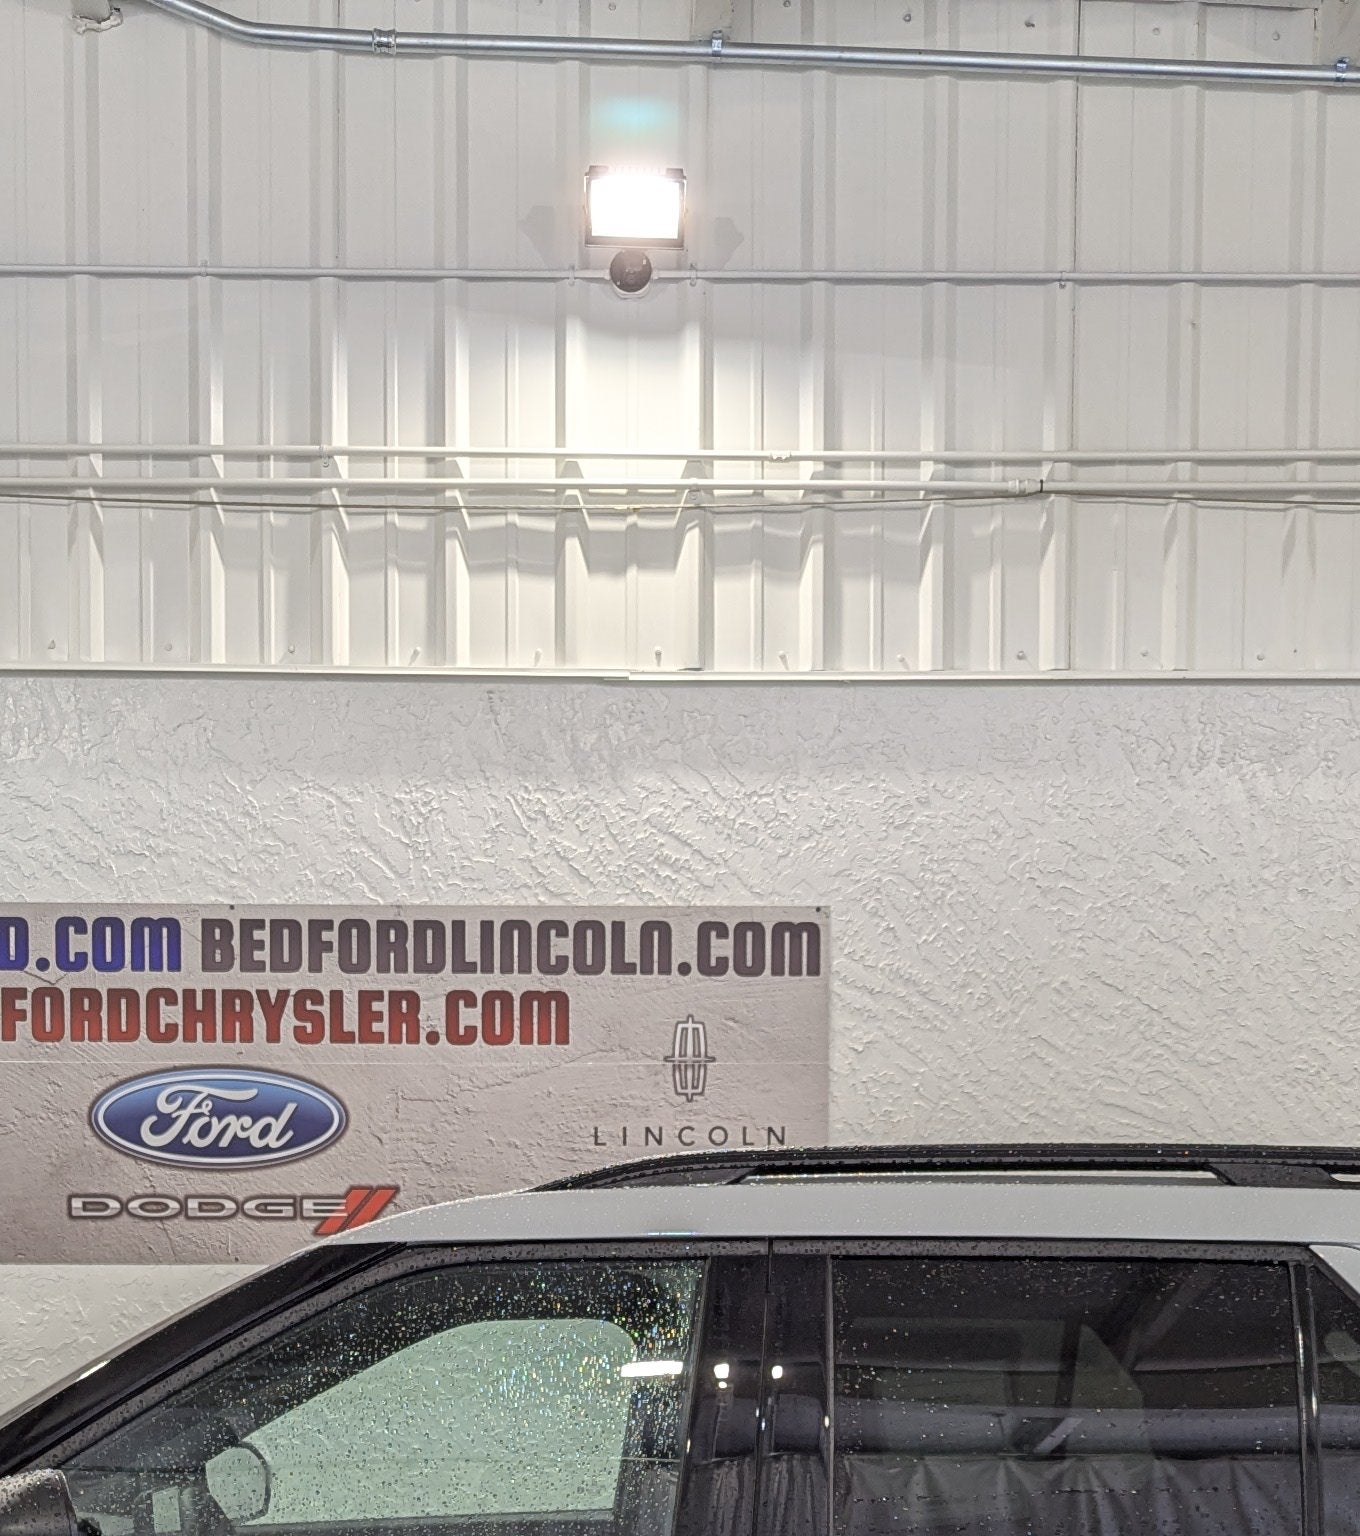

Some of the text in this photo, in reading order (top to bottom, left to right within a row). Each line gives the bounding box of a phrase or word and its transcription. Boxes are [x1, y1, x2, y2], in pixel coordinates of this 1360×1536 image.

[201, 917, 822, 977] BEDFORDLINCOLN.COM
[139, 1084, 299, 1149] Ford
[593, 1125, 786, 1147] LINCOLN
[68, 1195, 350, 1220] DODGE
